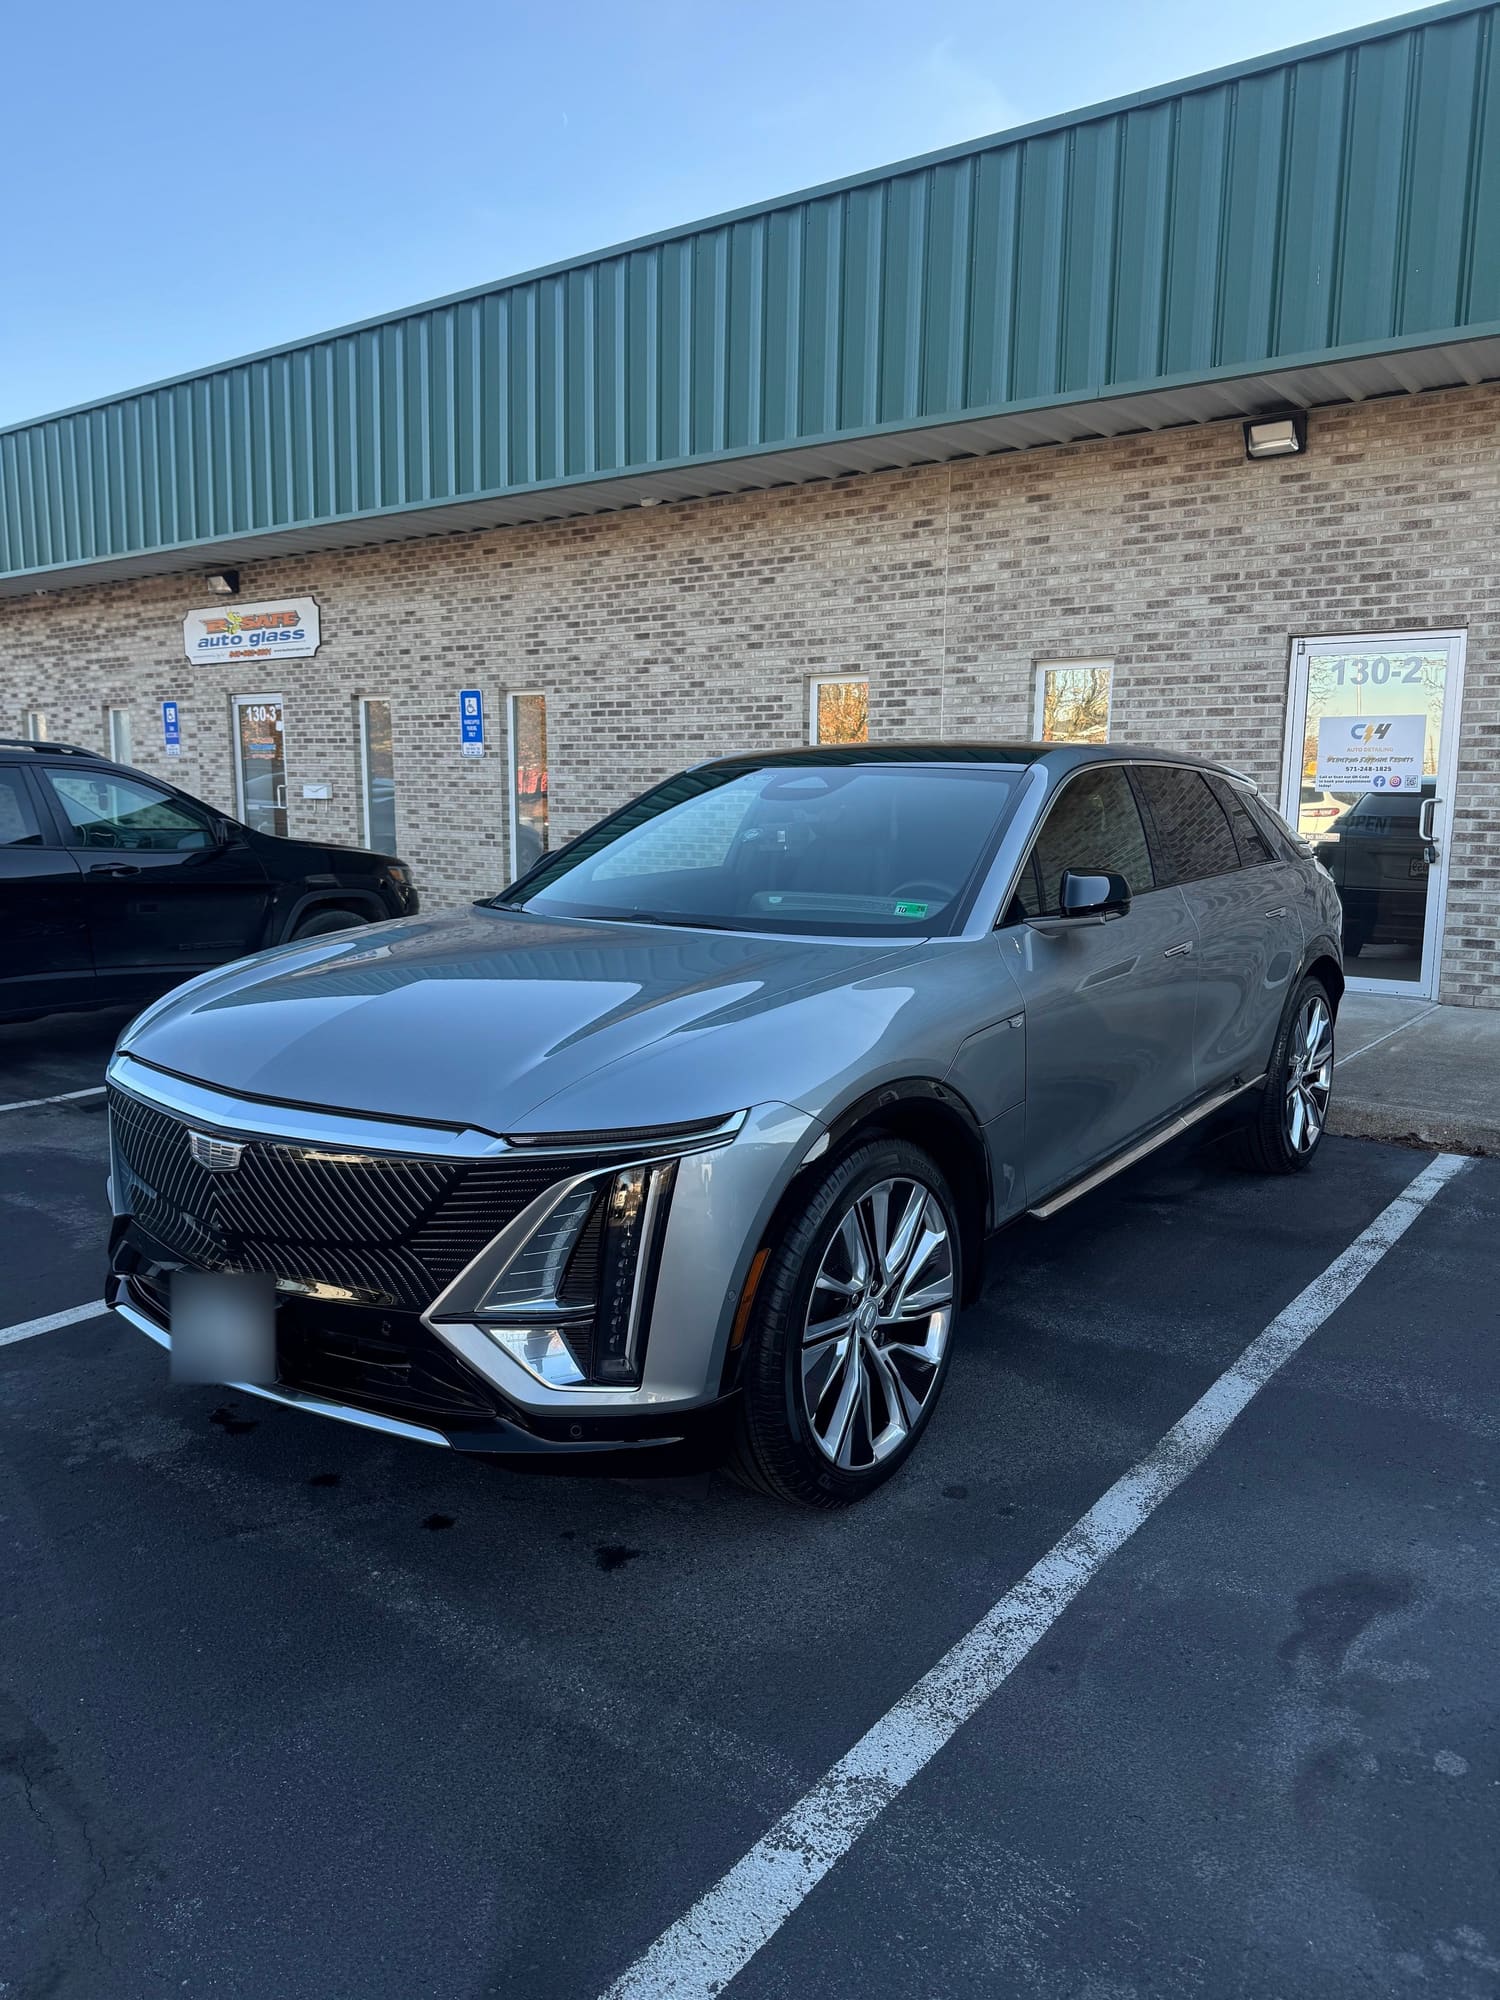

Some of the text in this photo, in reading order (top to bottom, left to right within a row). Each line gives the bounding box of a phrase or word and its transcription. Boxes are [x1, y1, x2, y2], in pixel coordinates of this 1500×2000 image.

[240, 610, 301, 631] SAFE
[198, 629, 305, 648] auto glass
[1331, 656, 1423, 686] 130-2
[246, 706, 277, 722] 130-3
